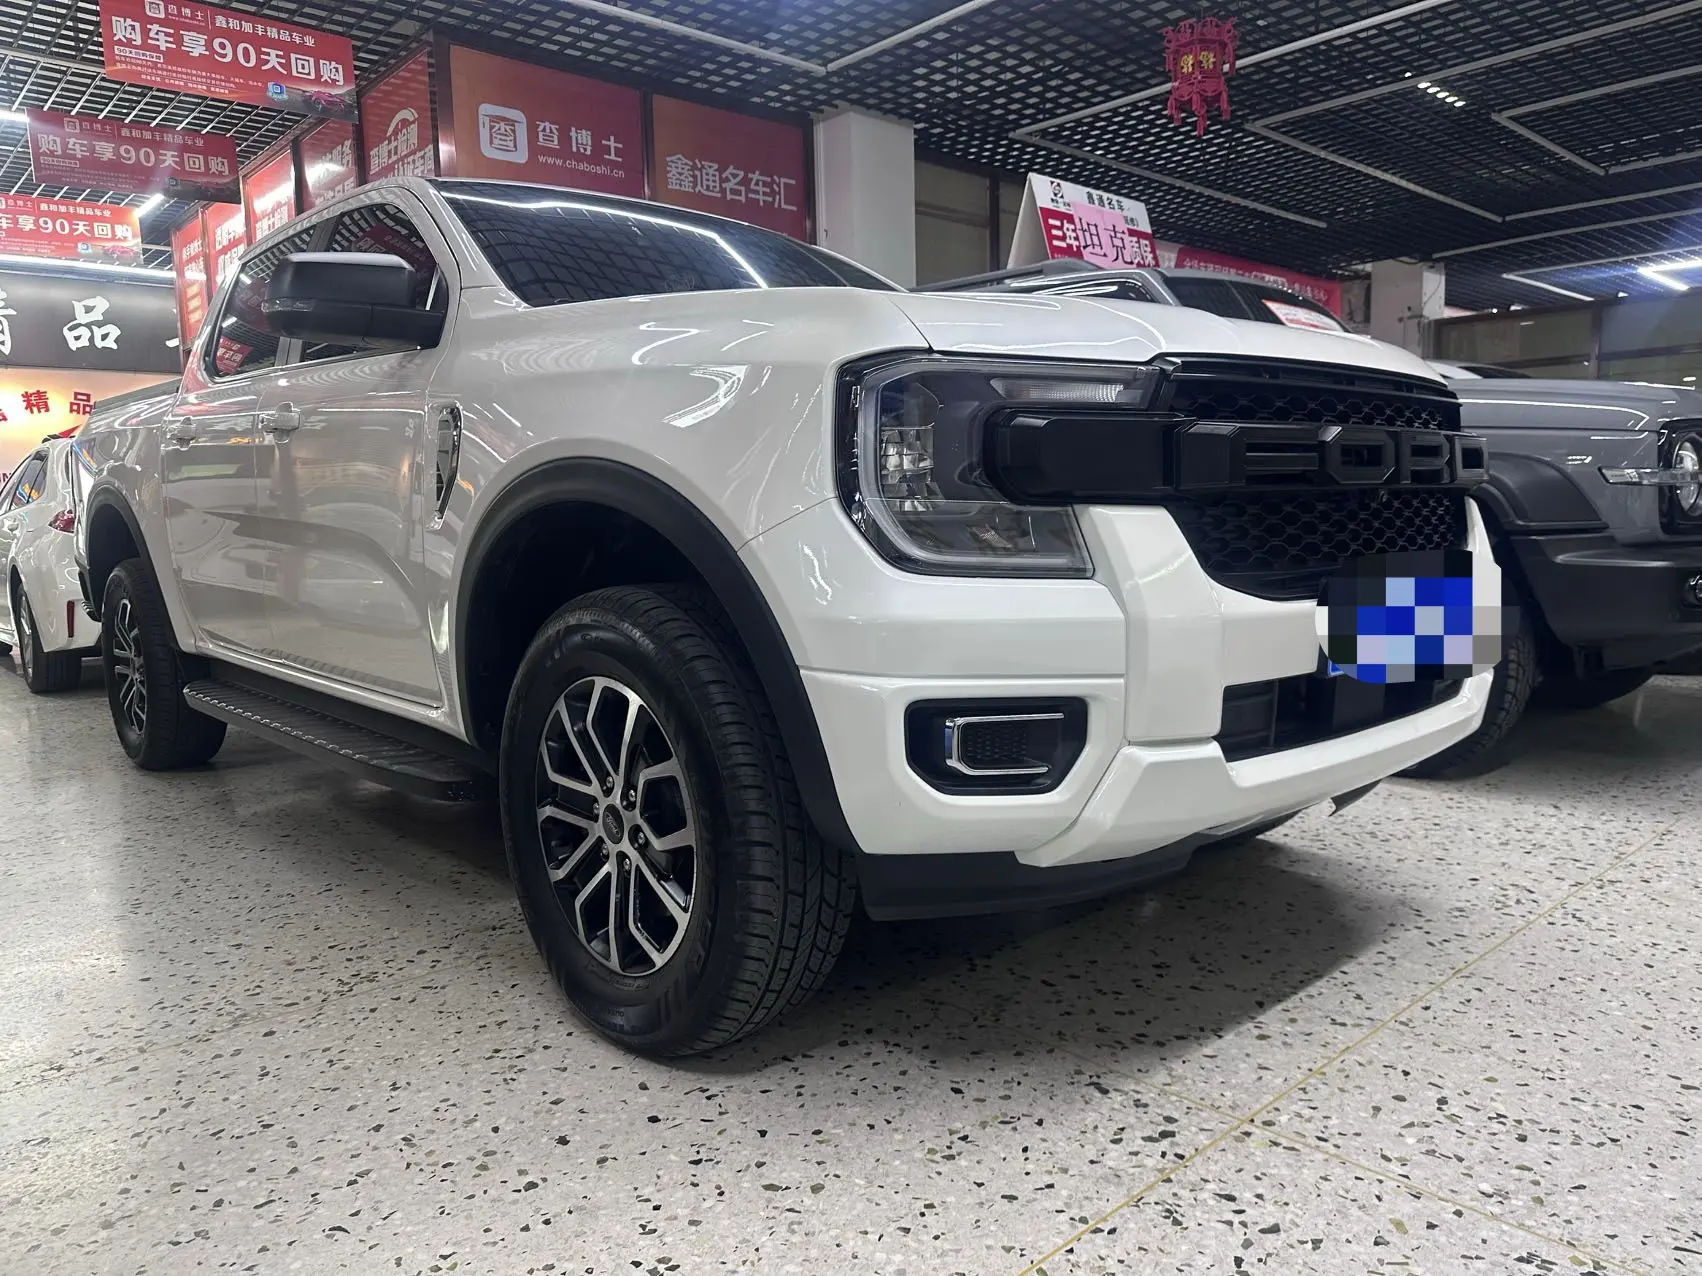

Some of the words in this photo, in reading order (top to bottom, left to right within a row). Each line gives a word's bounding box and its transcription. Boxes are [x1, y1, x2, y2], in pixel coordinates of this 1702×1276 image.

[112, 16, 344, 86] 购车享90天回购
[215, 15, 316, 47] 鑫和加丰精品车业
[37, 133, 229, 176] 购车享90天回购
[120, 127, 205, 147] 鑫和加丰精品车业
[536, 120, 624, 162] 查博士
[537, 154, 625, 178] www.chaboshi.cn
[666, 153, 798, 212] 鑫通名车汇
